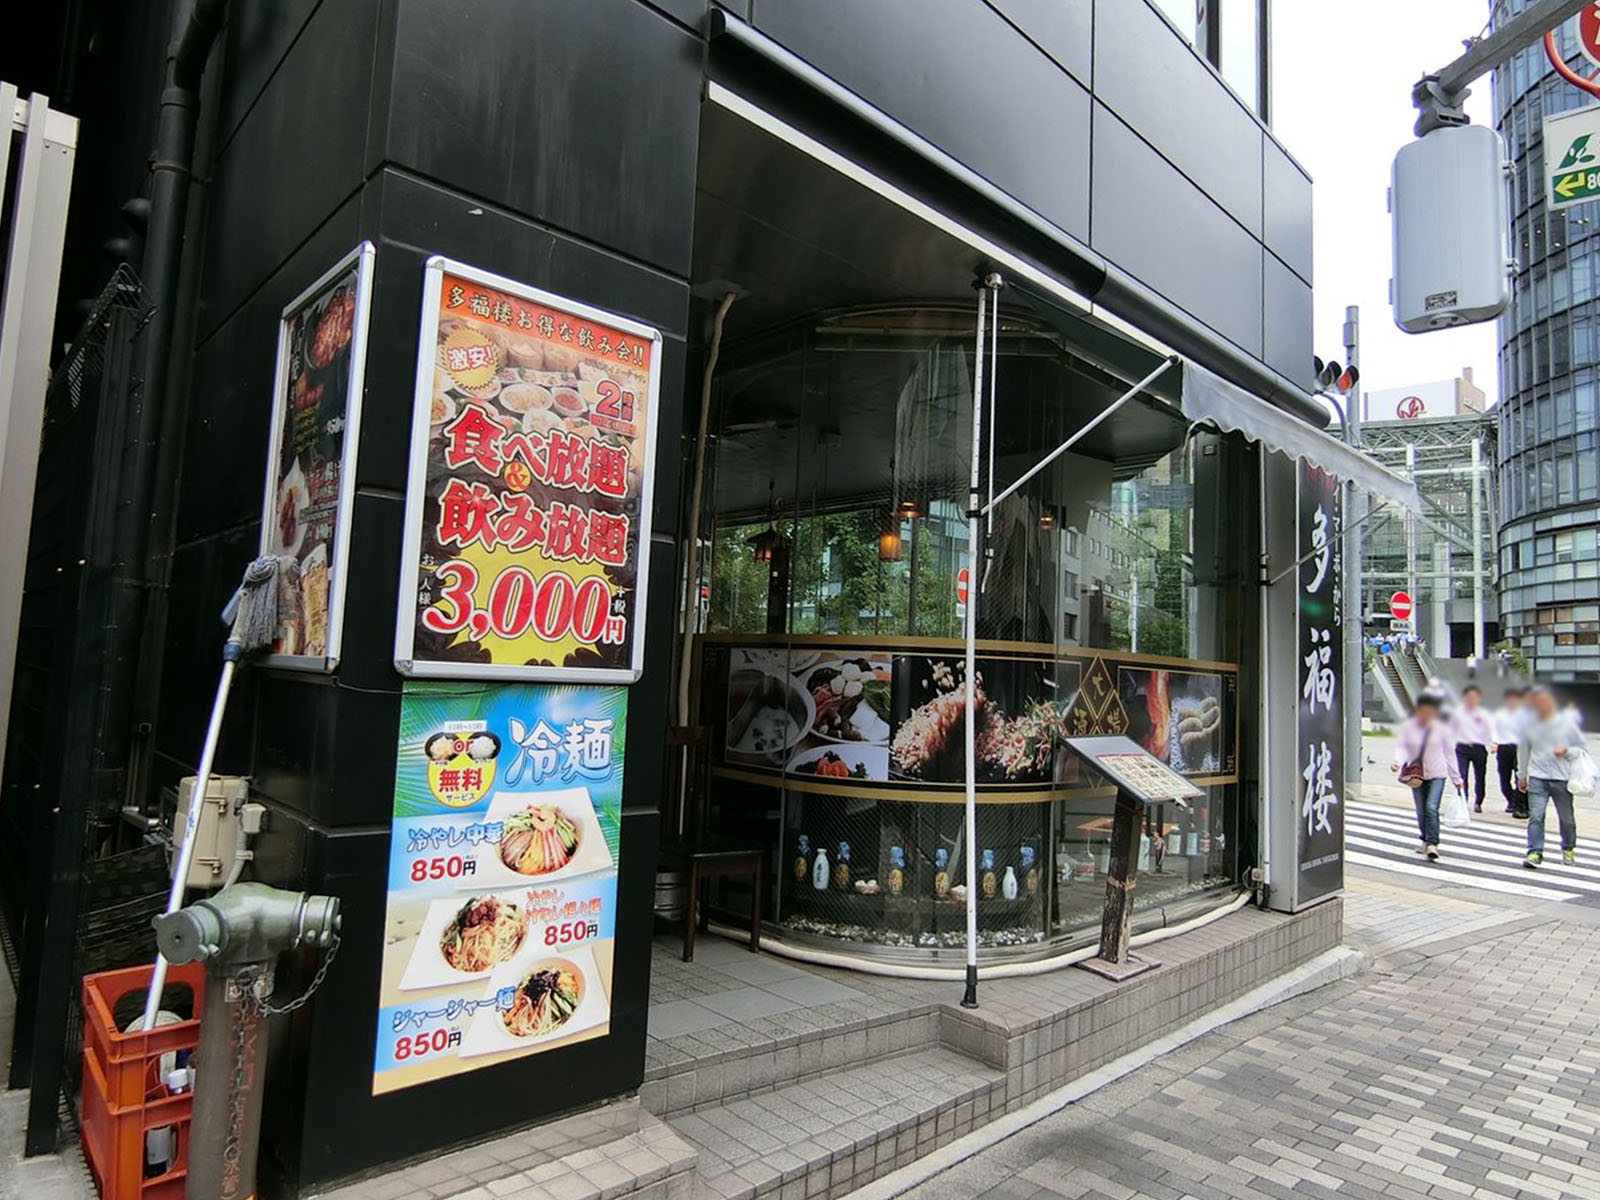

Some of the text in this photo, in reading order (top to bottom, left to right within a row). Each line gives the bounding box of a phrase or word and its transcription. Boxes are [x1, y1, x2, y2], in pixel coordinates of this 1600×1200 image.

[443, 403, 630, 498] 食べ放題
[436, 477, 630, 567] 飲み放題
[422, 560, 626, 644] 3,000円
[1303, 503, 1338, 838] 多福楼
[453, 740, 474, 753] or
[504, 718, 614, 786] 冷麺
[438, 767, 482, 792] 無料
[406, 821, 504, 854] 冷やし中華
[411, 856, 476, 883] 850円
[544, 920, 598, 946] 850円
[395, 1029, 461, 1060] 850円
